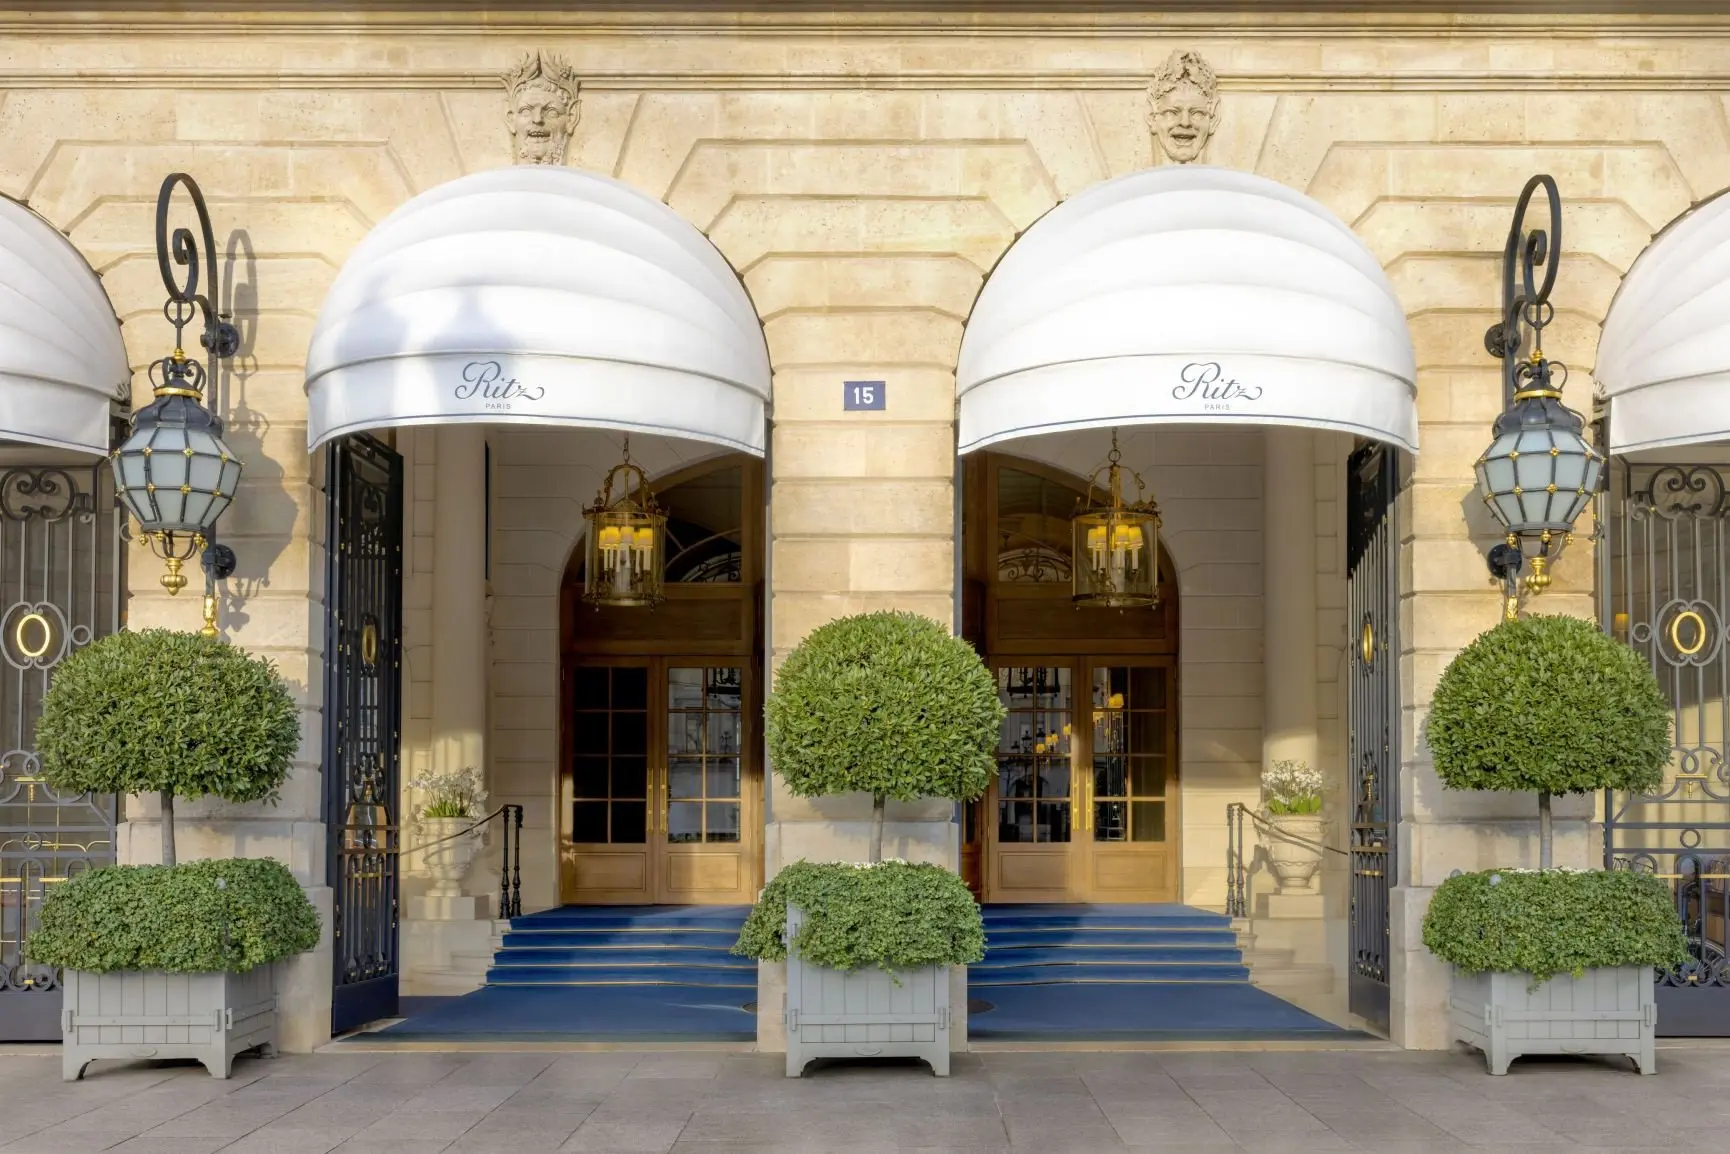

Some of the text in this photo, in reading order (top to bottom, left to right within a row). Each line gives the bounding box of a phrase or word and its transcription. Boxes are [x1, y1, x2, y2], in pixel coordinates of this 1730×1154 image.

[454, 361, 545, 401] Ritz
[853, 386, 874, 405] 15
[1172, 362, 1263, 401] Ritz
[1204, 403, 1231, 411] PARIS
